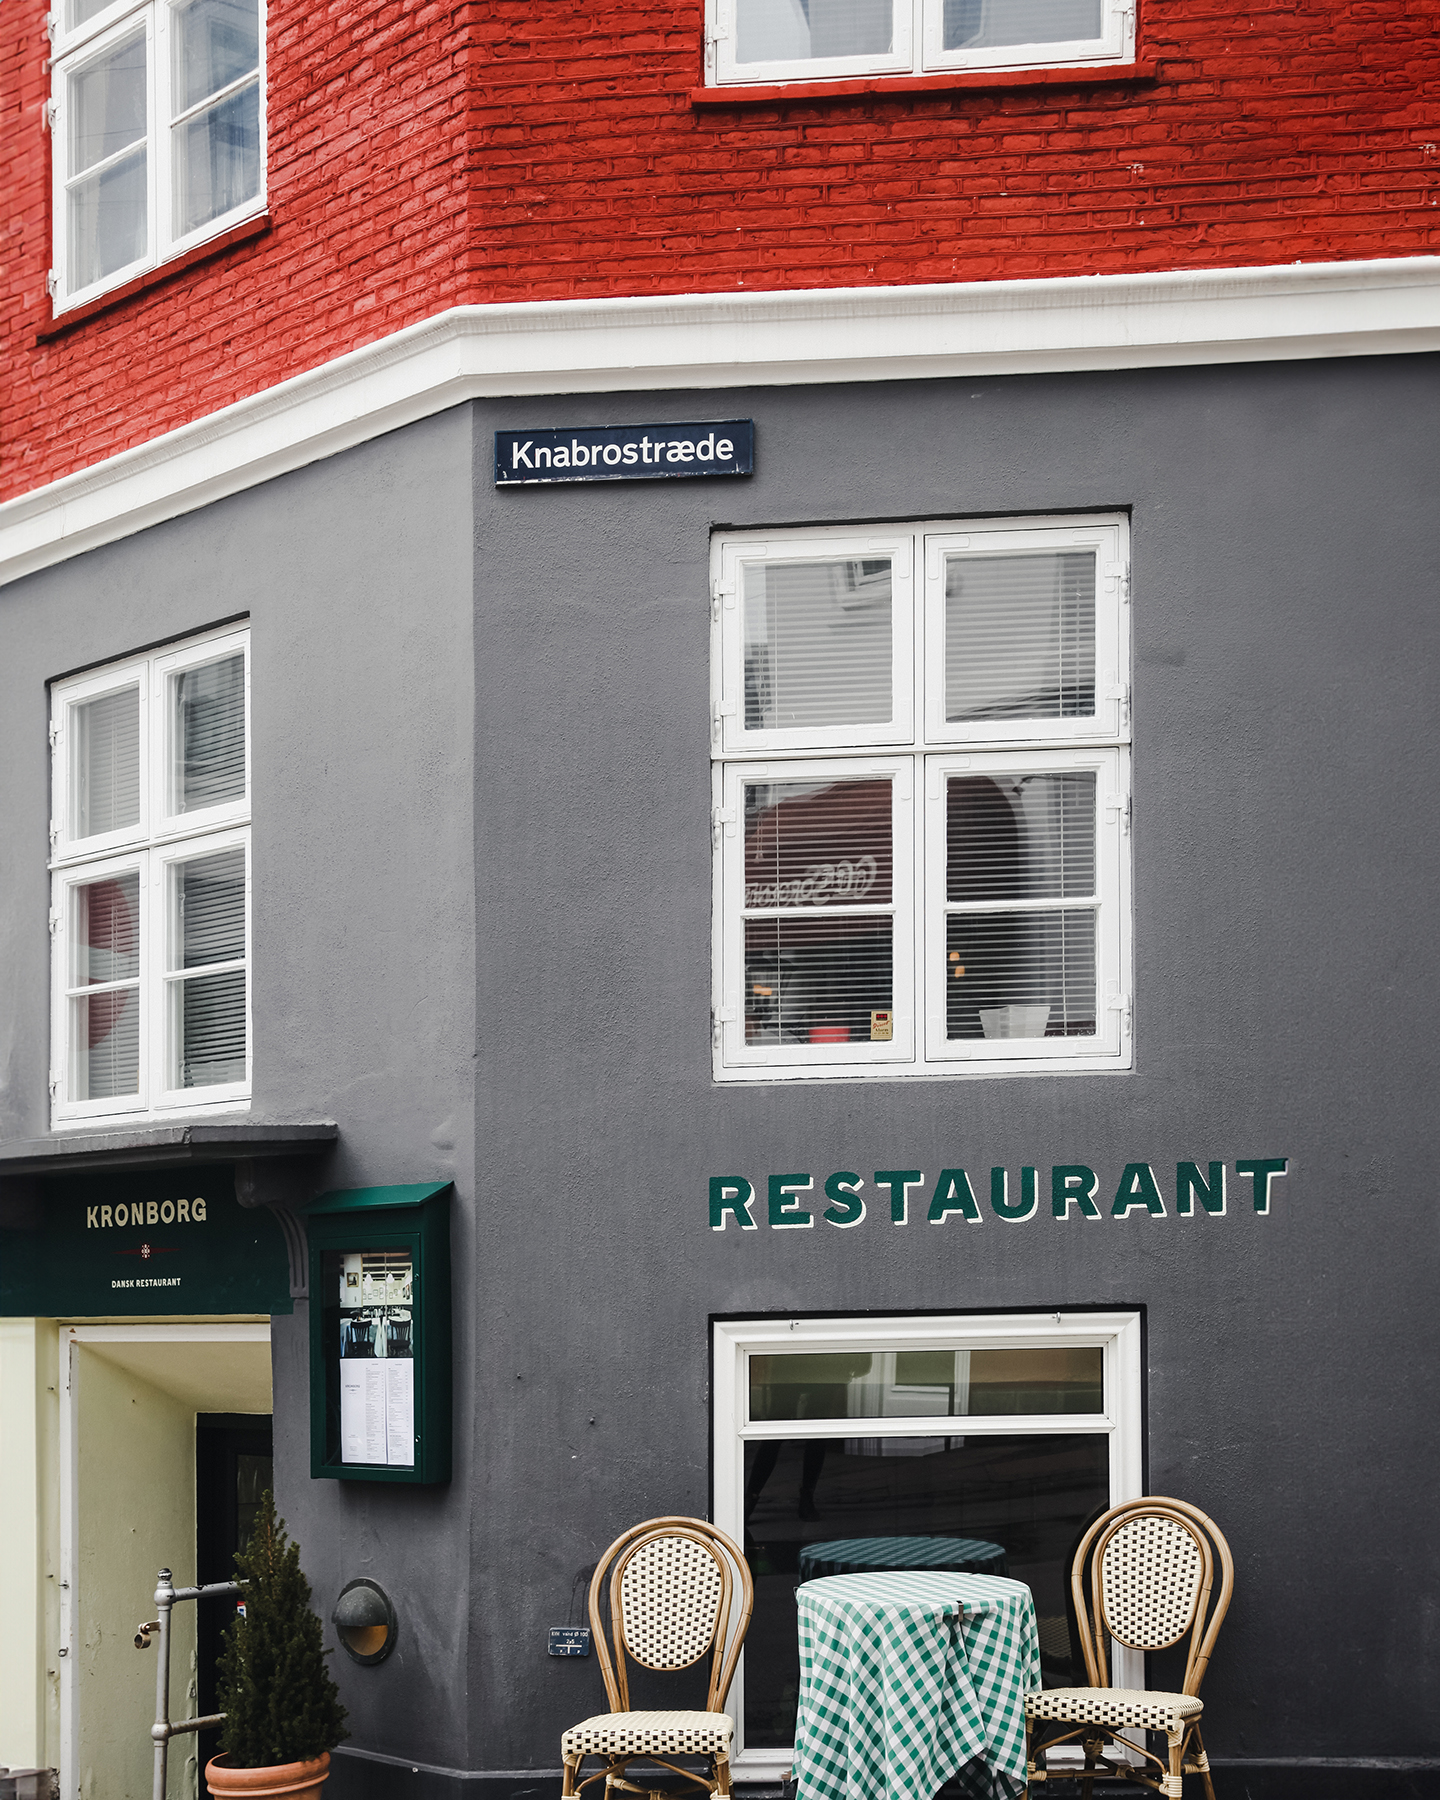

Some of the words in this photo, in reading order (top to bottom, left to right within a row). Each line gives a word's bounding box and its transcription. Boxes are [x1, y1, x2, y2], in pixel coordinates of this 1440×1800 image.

[512, 433, 734, 469] Knabrostræde
[708, 1158, 1288, 1231] RESTAURANT
[86, 1197, 207, 1228] KRONBORG
[111, 1279, 135, 1289] DANSK
[135, 1277, 181, 1288] RESTAURANT
